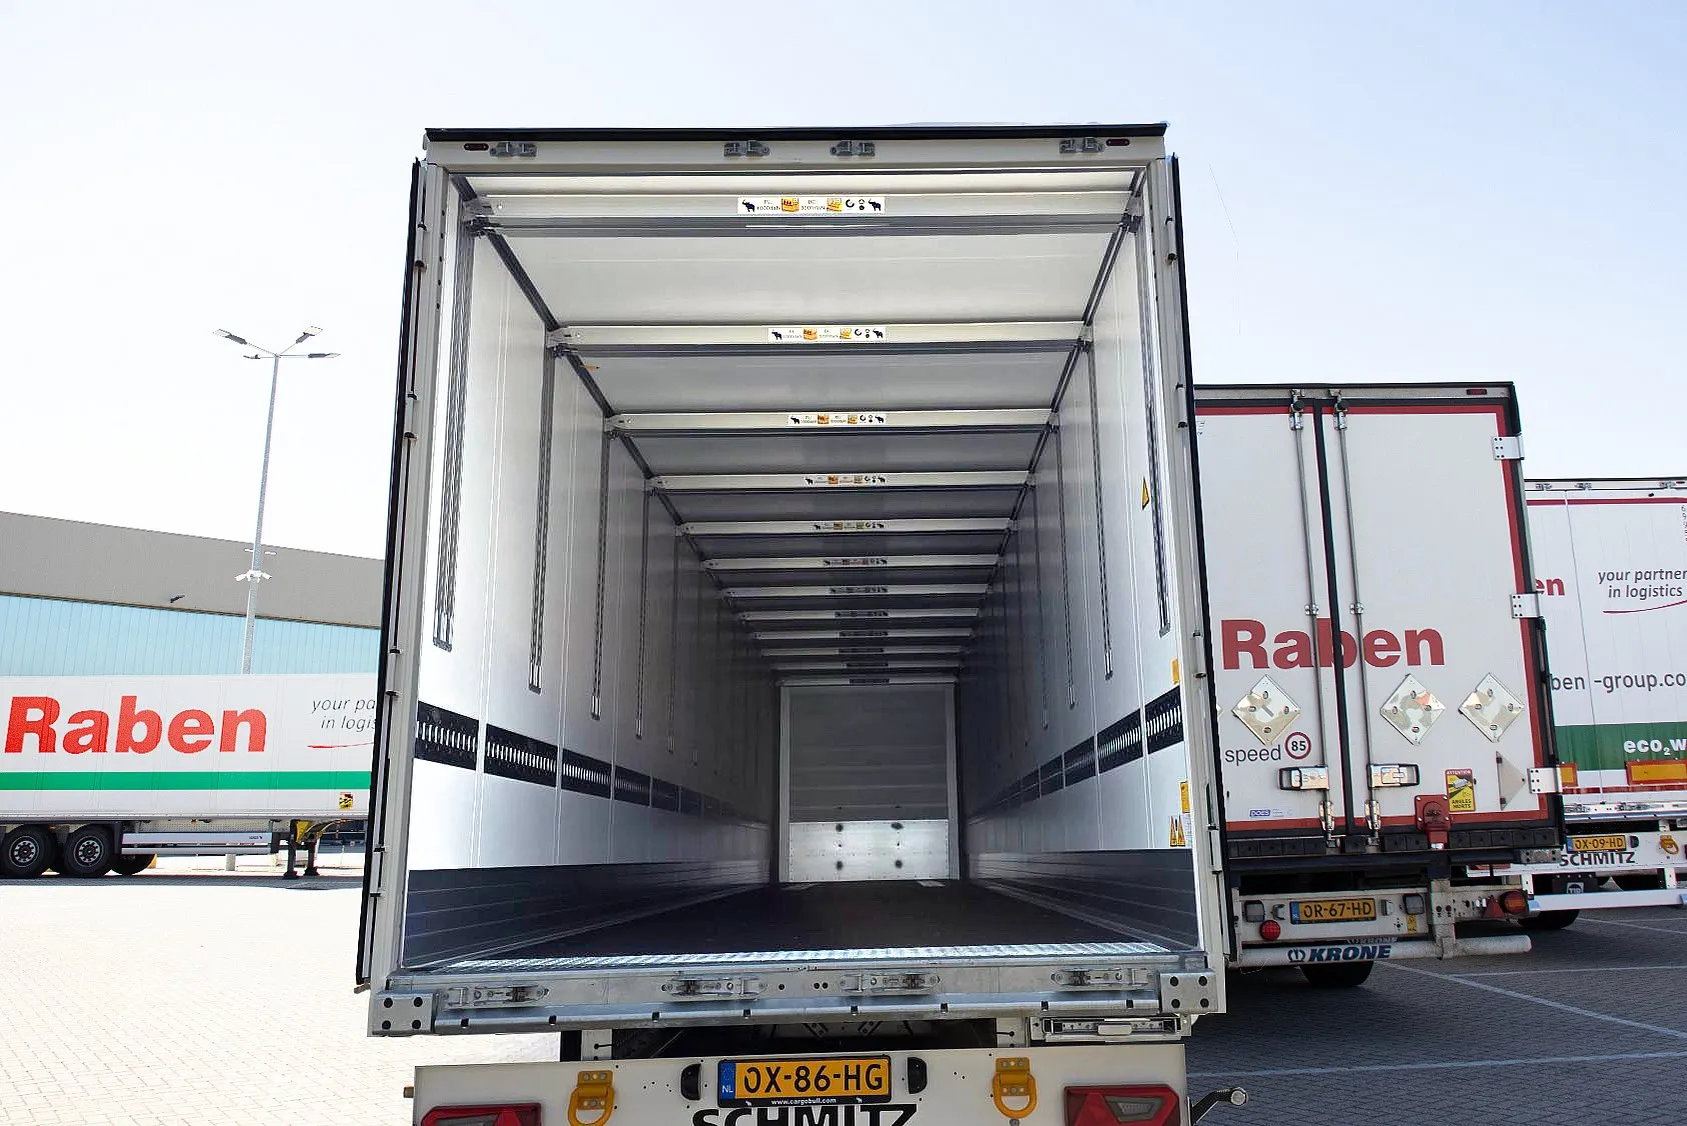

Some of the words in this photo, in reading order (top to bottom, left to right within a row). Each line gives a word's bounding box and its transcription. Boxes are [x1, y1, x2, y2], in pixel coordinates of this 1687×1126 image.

[1598, 571, 1631, 584] your
[1634, 568, 1687, 583] partner
[1608, 585, 1621, 598] in
[1625, 585, 1683, 600] logistics
[1221, 618, 1445, 671] Raben
[312, 699, 350, 714] your
[4, 695, 267, 755] Raben
[320, 716, 336, 729] in
[1225, 744, 1281, 766] speed
[1289, 739, 1308, 753] 85
[1574, 838, 1624, 850] OX-09-HD
[1559, 851, 1636, 867] SCHMITZ
[1303, 901, 1372, 919] OR-67-HD
[1308, 945, 1392, 962] KRONE
[722, 1084, 734, 1094] NL
[743, 1063, 883, 1095] OX-86-HG
[771, 1096, 837, 1106] www.cargobull.com
